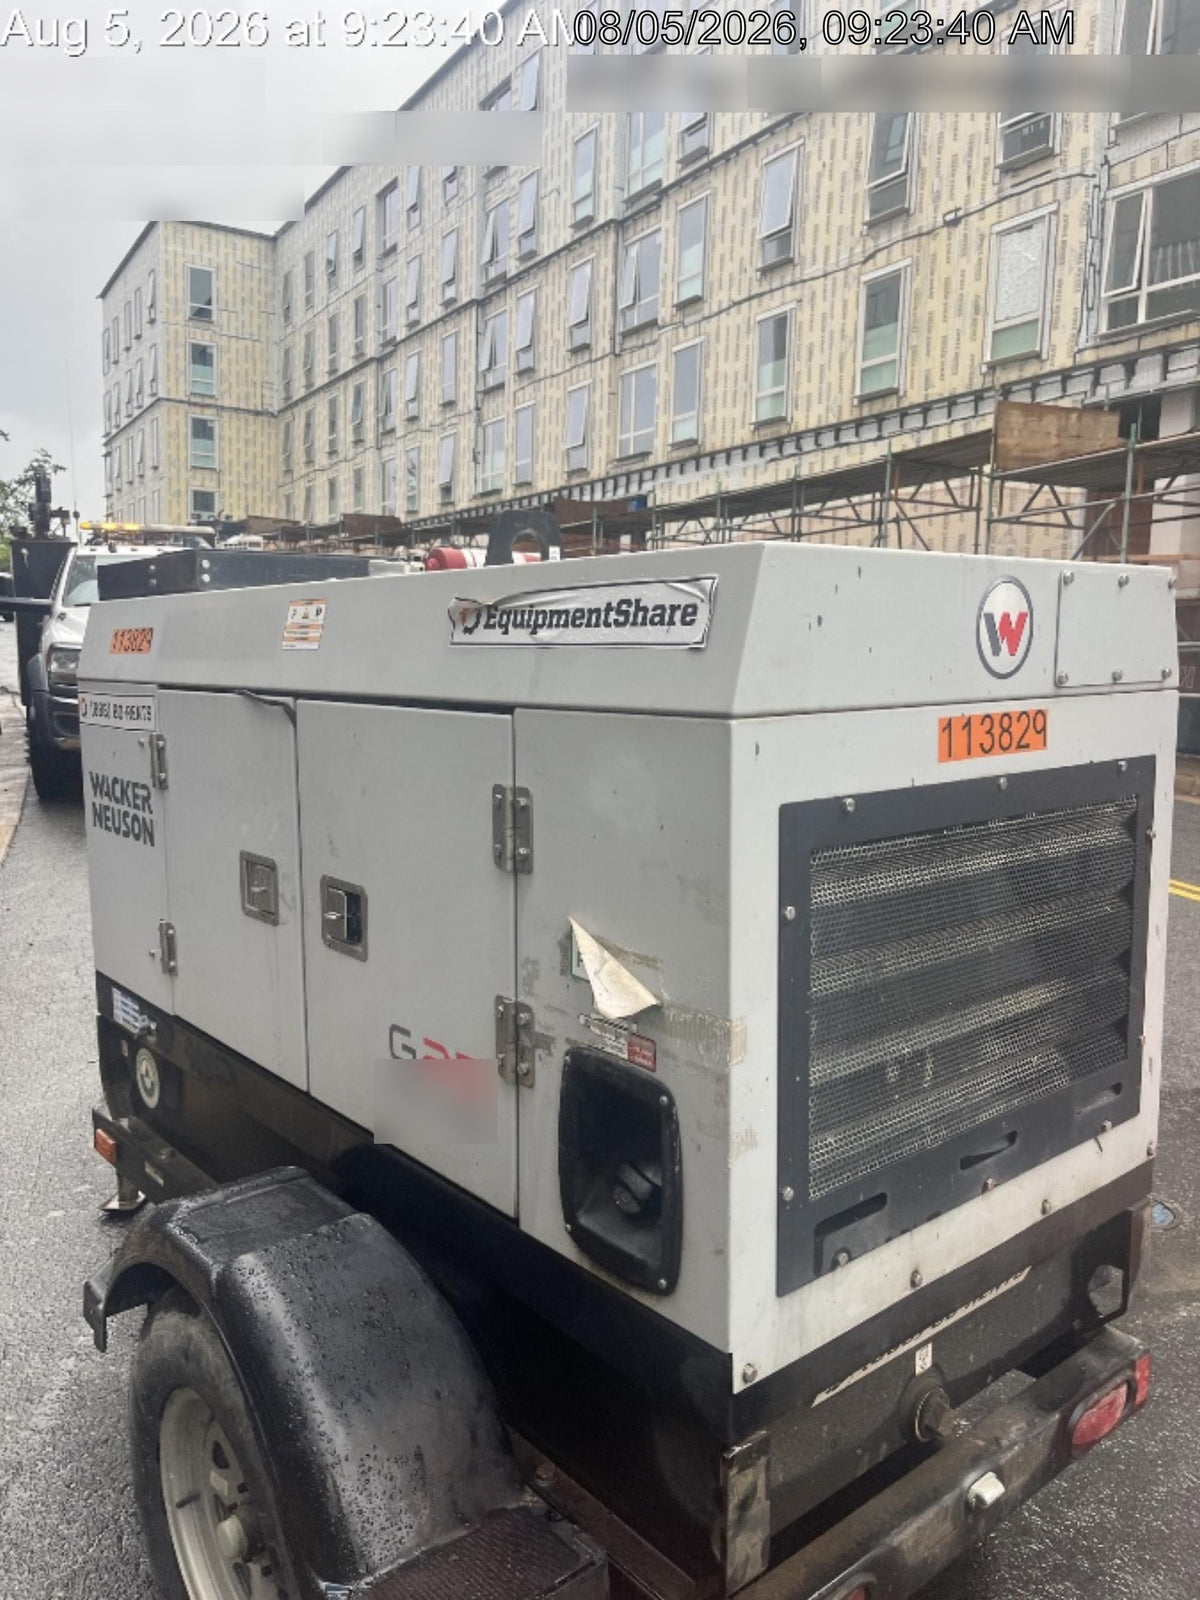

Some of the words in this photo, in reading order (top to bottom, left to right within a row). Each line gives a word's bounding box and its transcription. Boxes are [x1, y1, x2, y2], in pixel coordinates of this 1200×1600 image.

[483, 599, 699, 636] EquipmentShare
[941, 708, 1047, 758] 113829
[89, 771, 153, 815] WACKER
[92, 802, 155, 848] NEUSON
